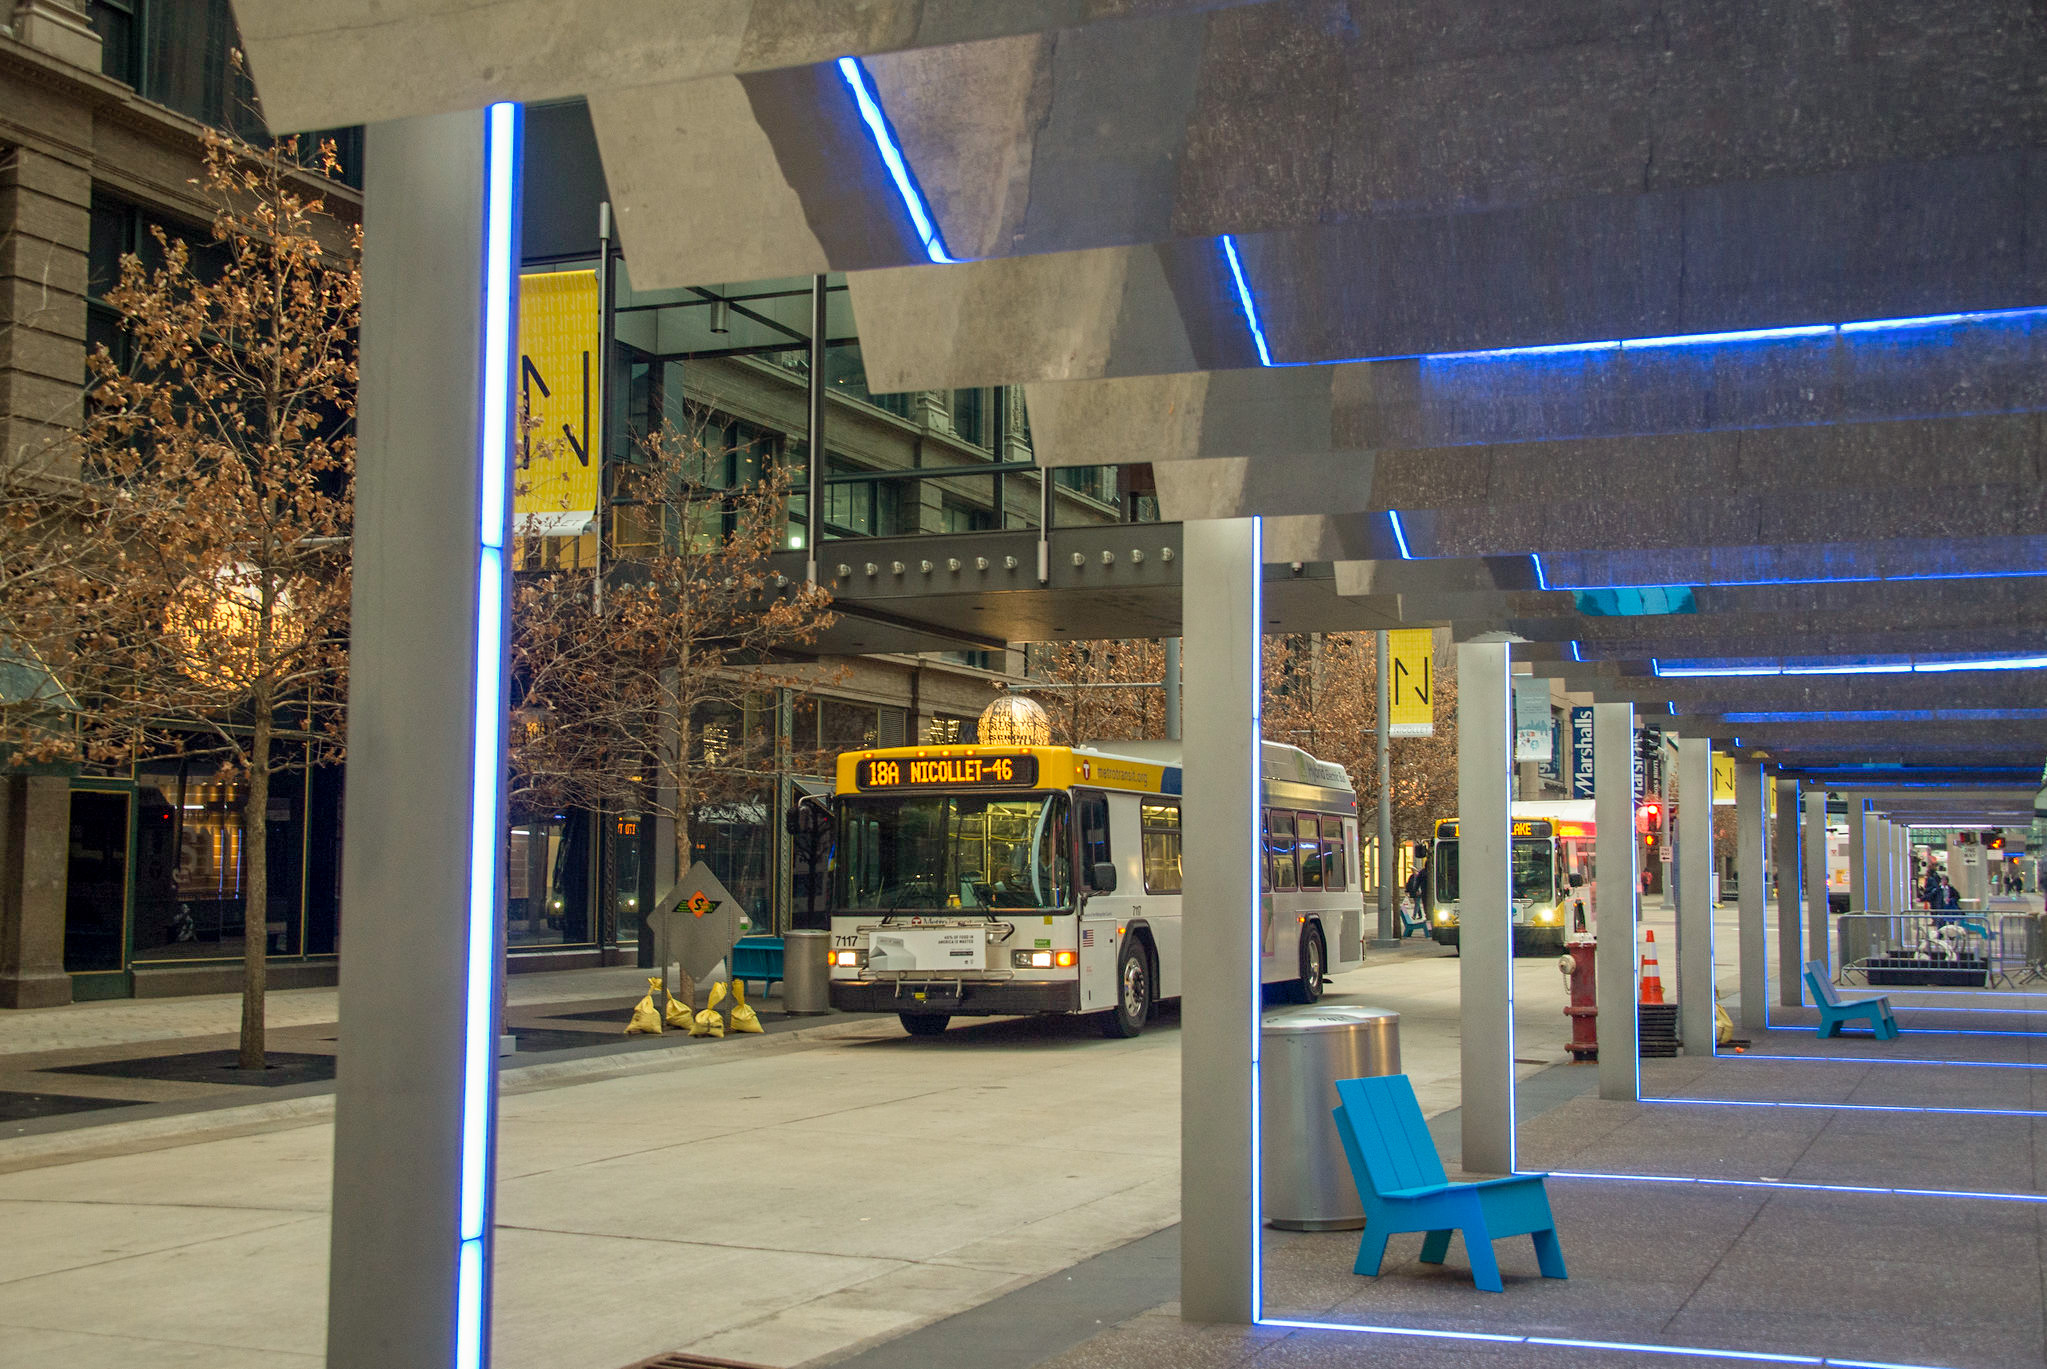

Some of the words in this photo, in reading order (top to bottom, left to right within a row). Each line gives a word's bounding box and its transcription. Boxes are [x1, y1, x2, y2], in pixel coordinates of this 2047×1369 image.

[1394, 656, 1428, 706] N
[1574, 710, 1594, 796] Marshalls
[869, 761, 900, 786] 18A
[910, 758, 1014, 784] NICOLLET-46
[1097, 767, 1148, 788] metrotransit.org
[835, 935, 859, 947] 7117
